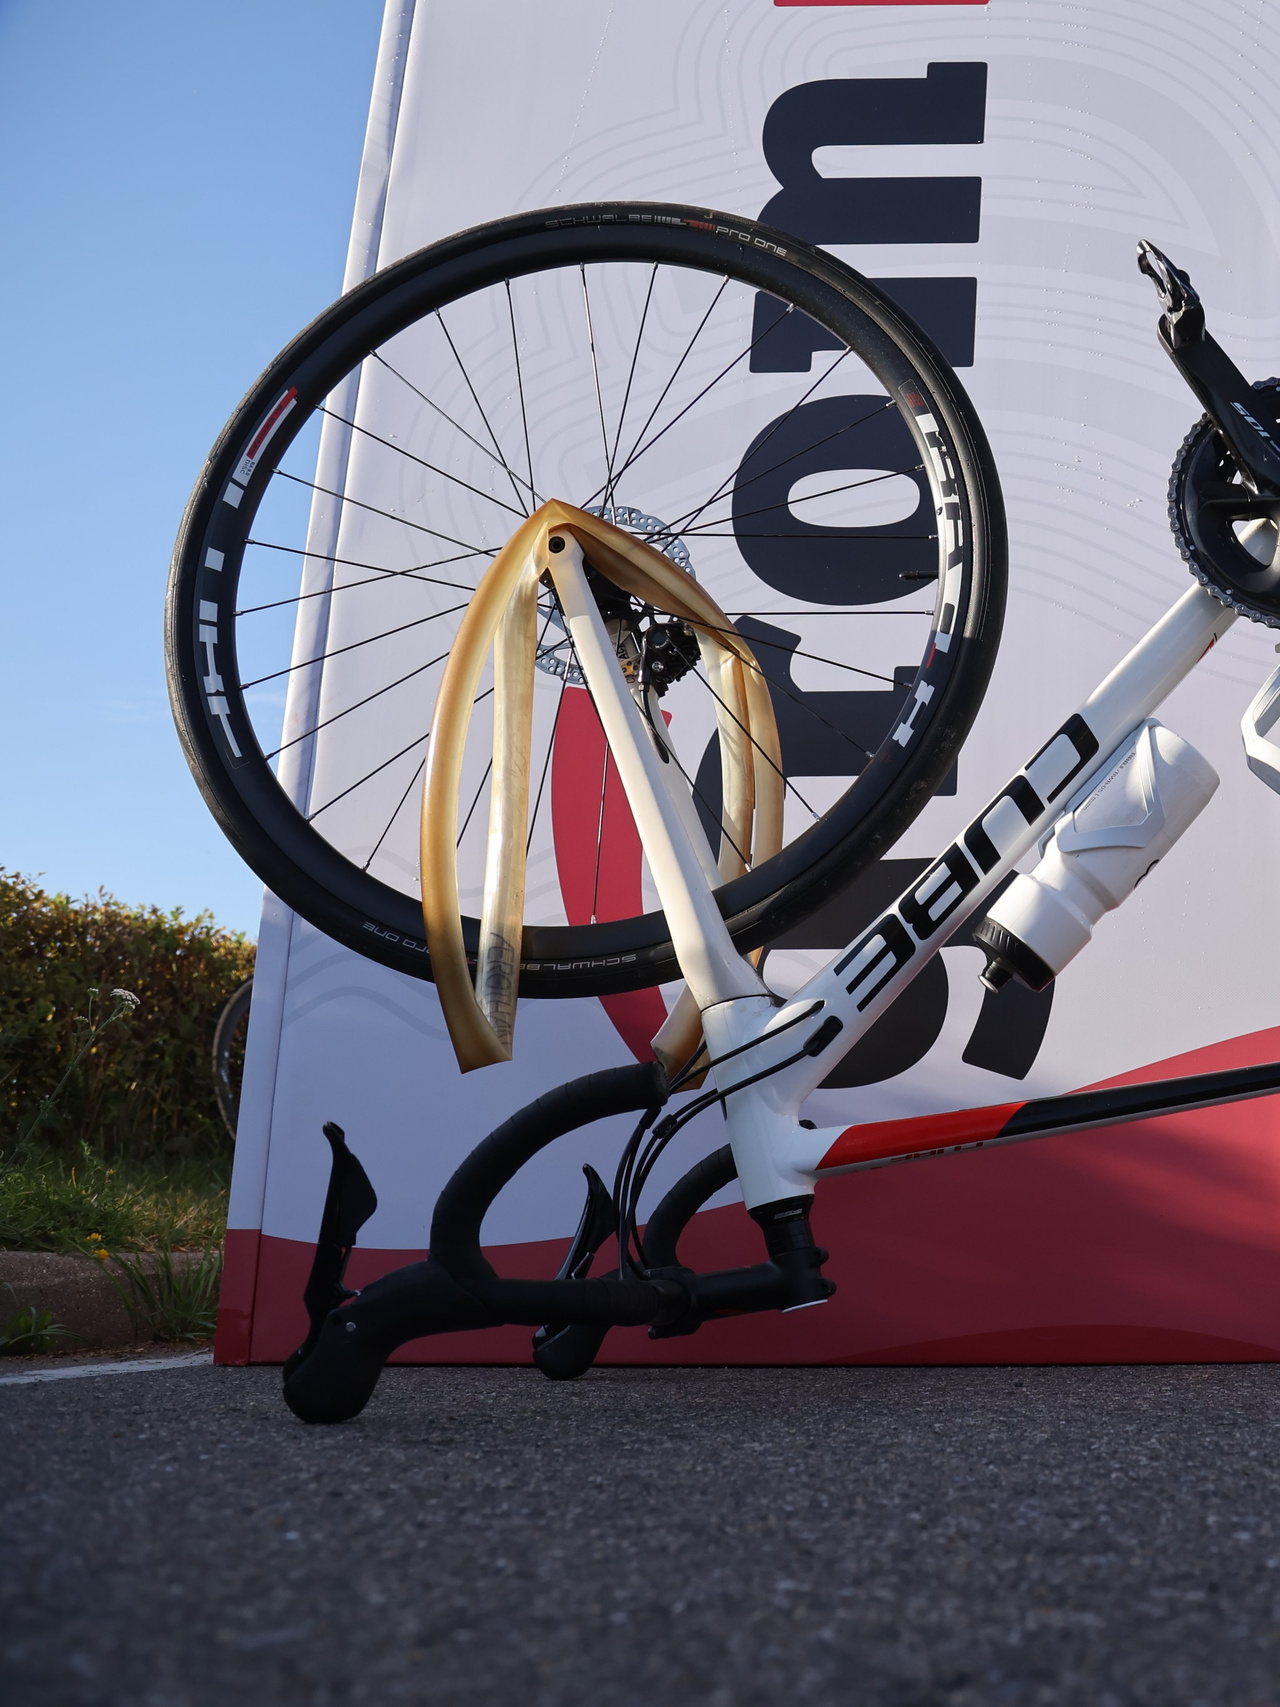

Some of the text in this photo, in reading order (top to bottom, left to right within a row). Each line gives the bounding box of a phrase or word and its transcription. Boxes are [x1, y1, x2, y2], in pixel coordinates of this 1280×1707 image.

[545, 213, 788, 257] SCHWALBE PRO ONE
[1229, 401, 1271, 438] 105
[833, 712, 1100, 1013] CUBE
